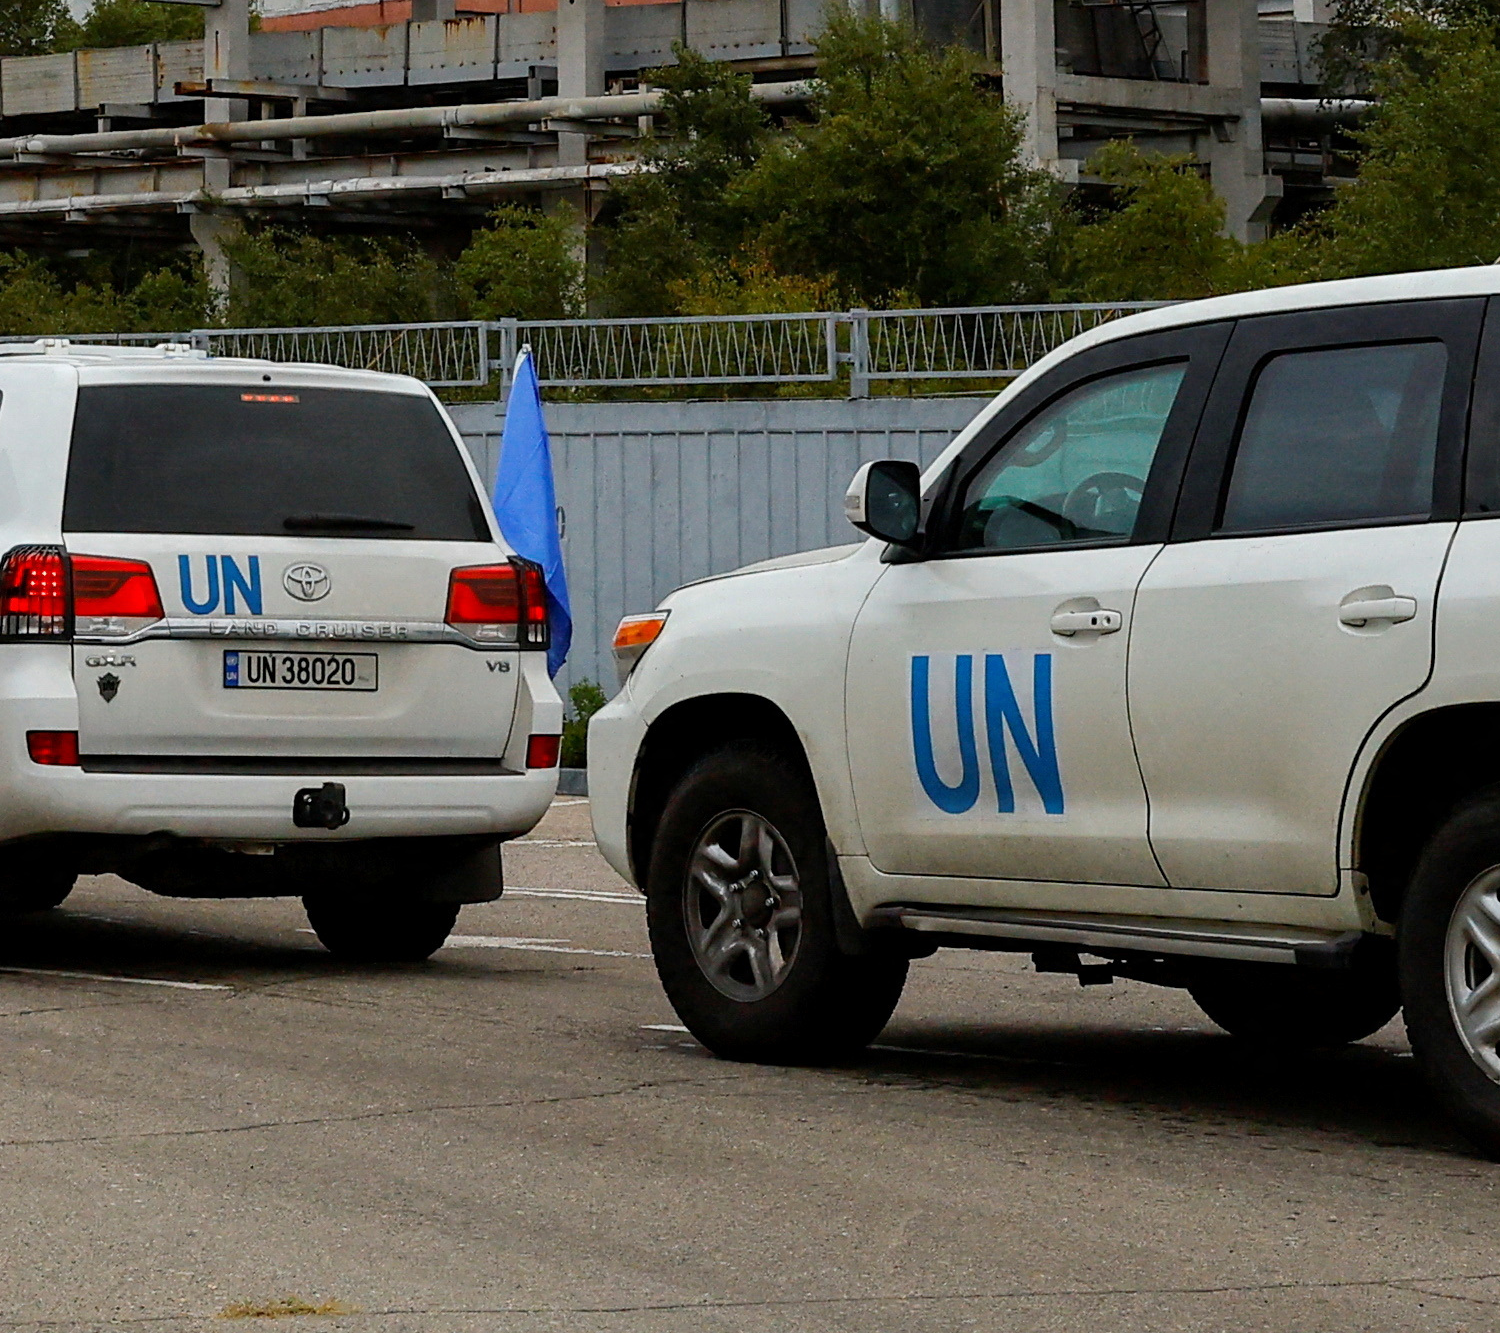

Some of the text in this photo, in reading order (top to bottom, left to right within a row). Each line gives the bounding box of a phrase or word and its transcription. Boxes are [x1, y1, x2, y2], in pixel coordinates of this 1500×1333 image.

[178, 555, 263, 615] UN
[209, 621, 410, 639] LAND CRUISER
[85, 654, 137, 668] GXR
[247, 655, 356, 686] UN 38020
[911, 653, 1065, 815] UN
